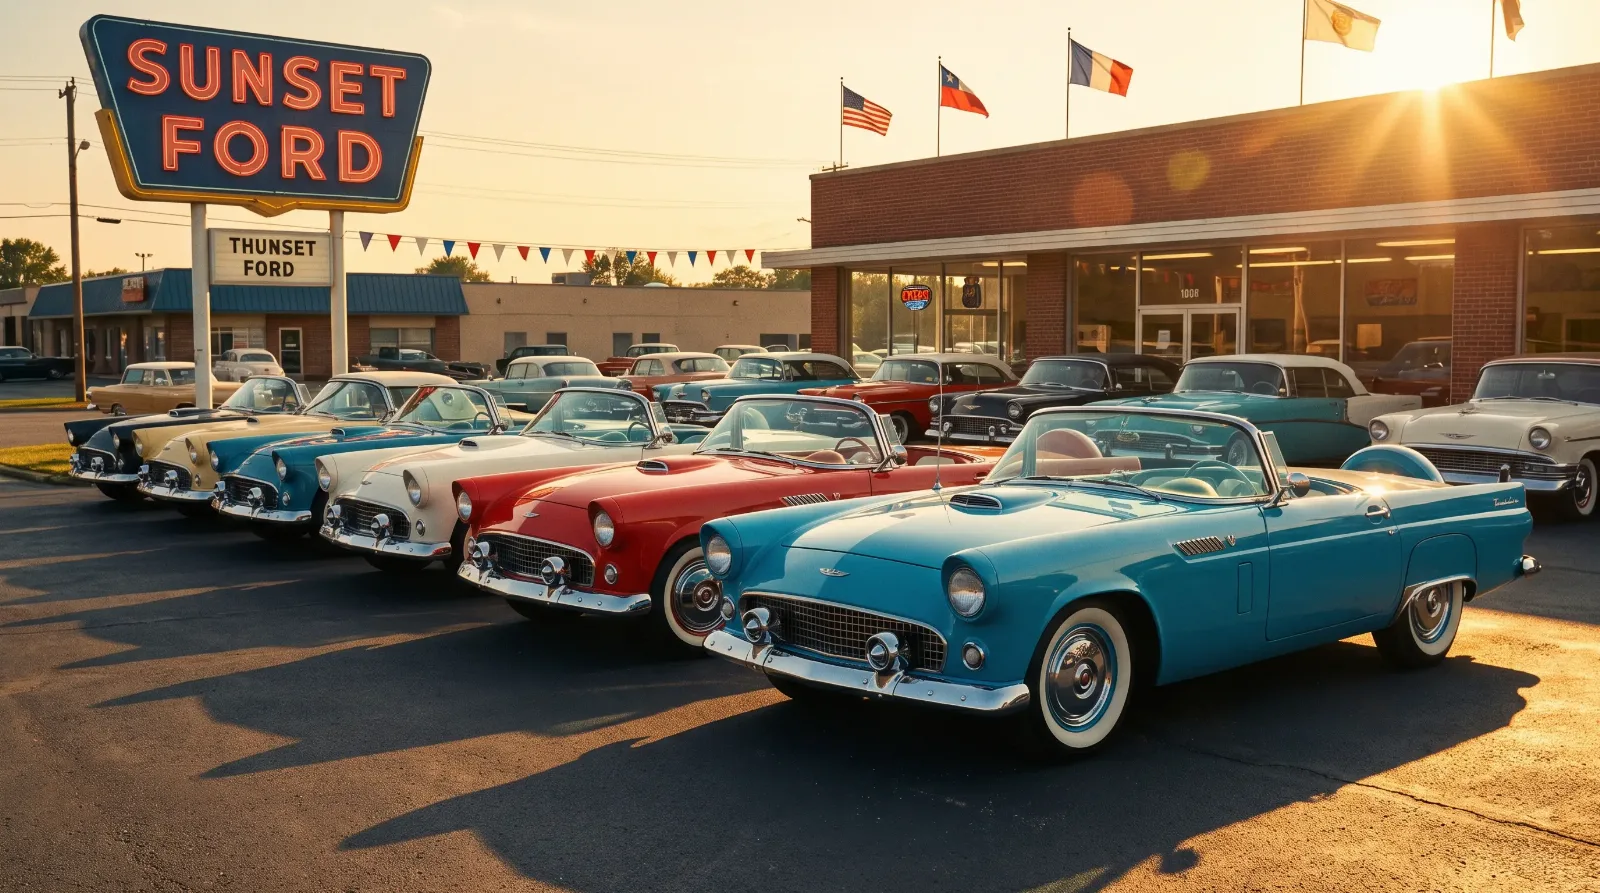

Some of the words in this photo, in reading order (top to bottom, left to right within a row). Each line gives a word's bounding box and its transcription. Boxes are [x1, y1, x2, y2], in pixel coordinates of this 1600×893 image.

[127, 38, 407, 118] SUNSET
[162, 115, 383, 183] FORD
[229, 237, 316, 256] THUNSET
[244, 260, 294, 277] FORD
